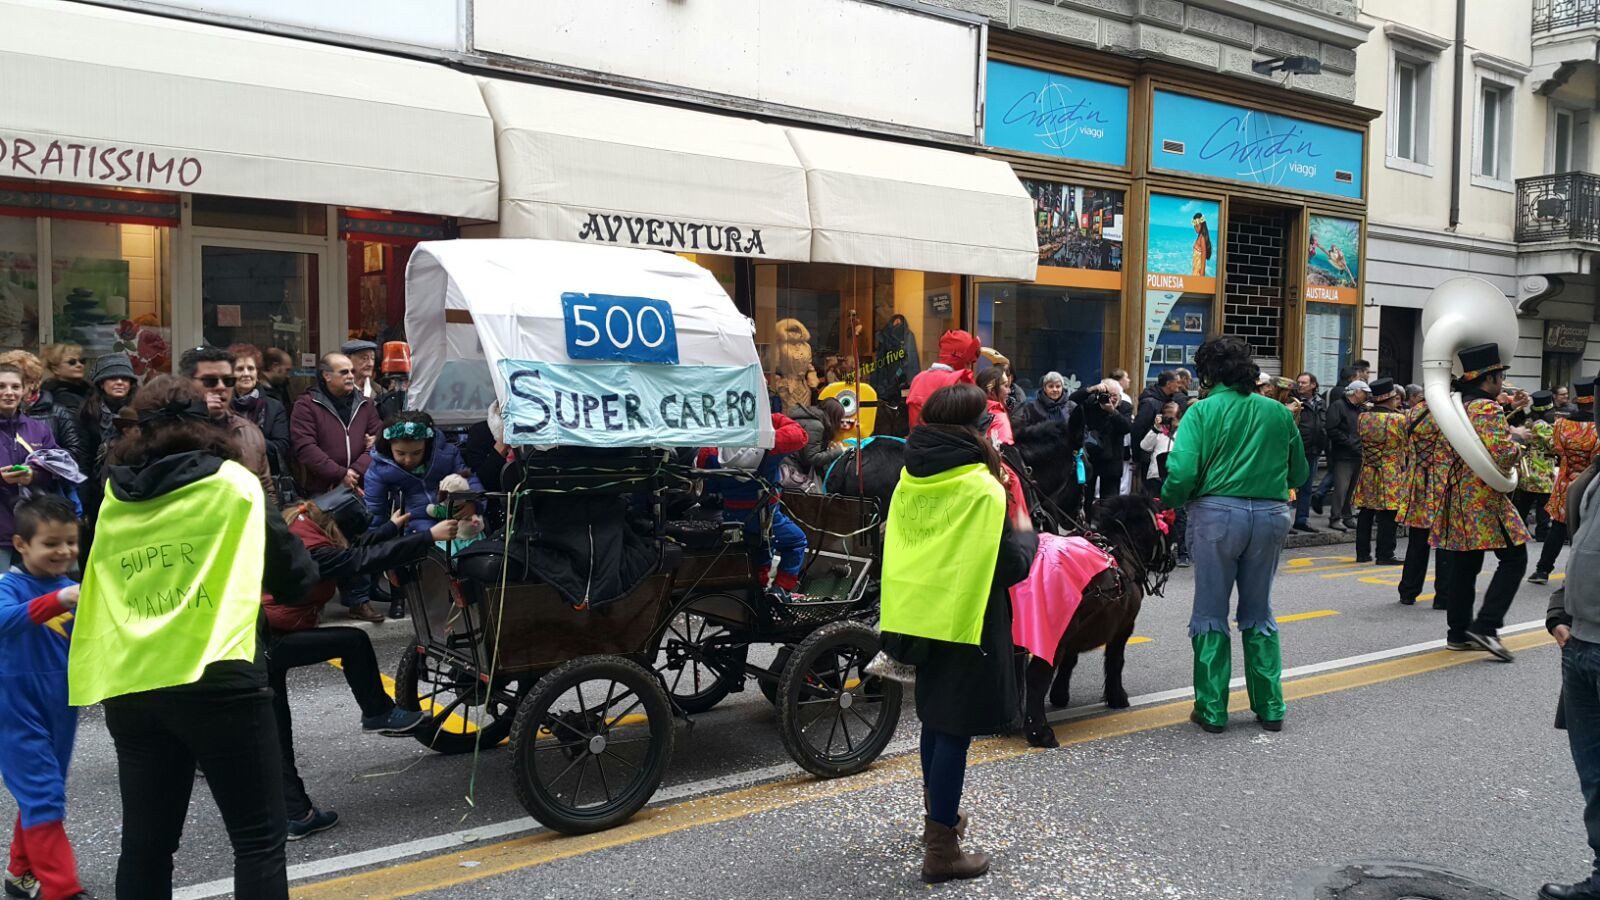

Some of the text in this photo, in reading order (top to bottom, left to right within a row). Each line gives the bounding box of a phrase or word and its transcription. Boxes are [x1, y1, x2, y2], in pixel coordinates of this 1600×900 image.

[1079, 126, 1105, 139] viaggi
[1288, 162, 1318, 178] viaggi
[578, 212, 766, 255] AVVENTURA
[1147, 274, 1184, 289] POLINESIA
[1306, 287, 1339, 300] AUSTRALIA
[573, 304, 667, 349] 500
[508, 369, 650, 434] SUPER
[120, 542, 195, 581] SUPER
[124, 582, 213, 624] MAMMA
